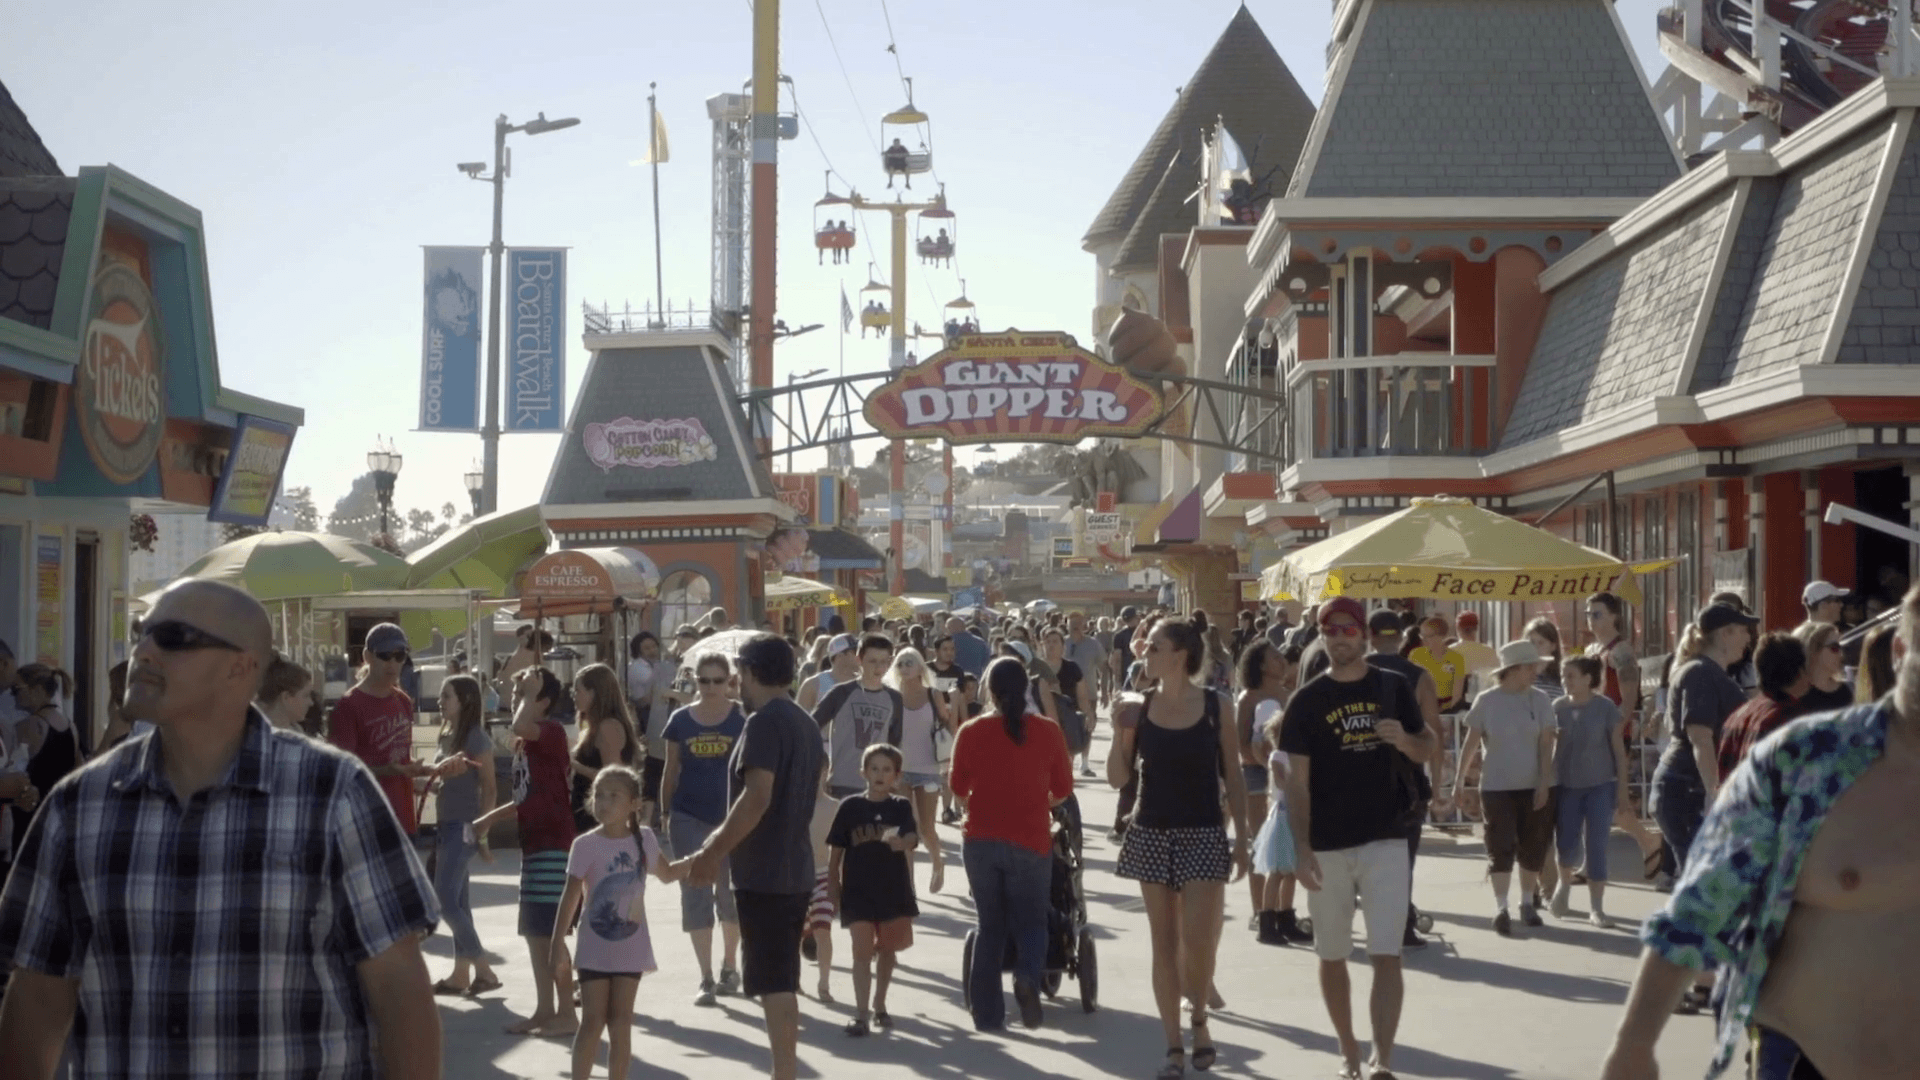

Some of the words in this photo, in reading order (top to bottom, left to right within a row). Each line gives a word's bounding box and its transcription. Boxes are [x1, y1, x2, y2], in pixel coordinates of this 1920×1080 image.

[430, 327, 446, 372] SURF
[516, 256, 554, 428] Boardwalk
[85, 307, 160, 425] Tickets
[943, 360, 1080, 386] GIANT
[426, 373, 443, 426] COOL
[901, 387, 1128, 426] DIPPER
[1087, 514, 1119, 525] GUEST
[535, 575, 599, 587] ESPRESSO
[550, 565, 583, 576] CAFE
[1431, 573, 1496, 595] Face
[1326, 707, 1343, 724] OFF
[1345, 702, 1364, 714] THE
